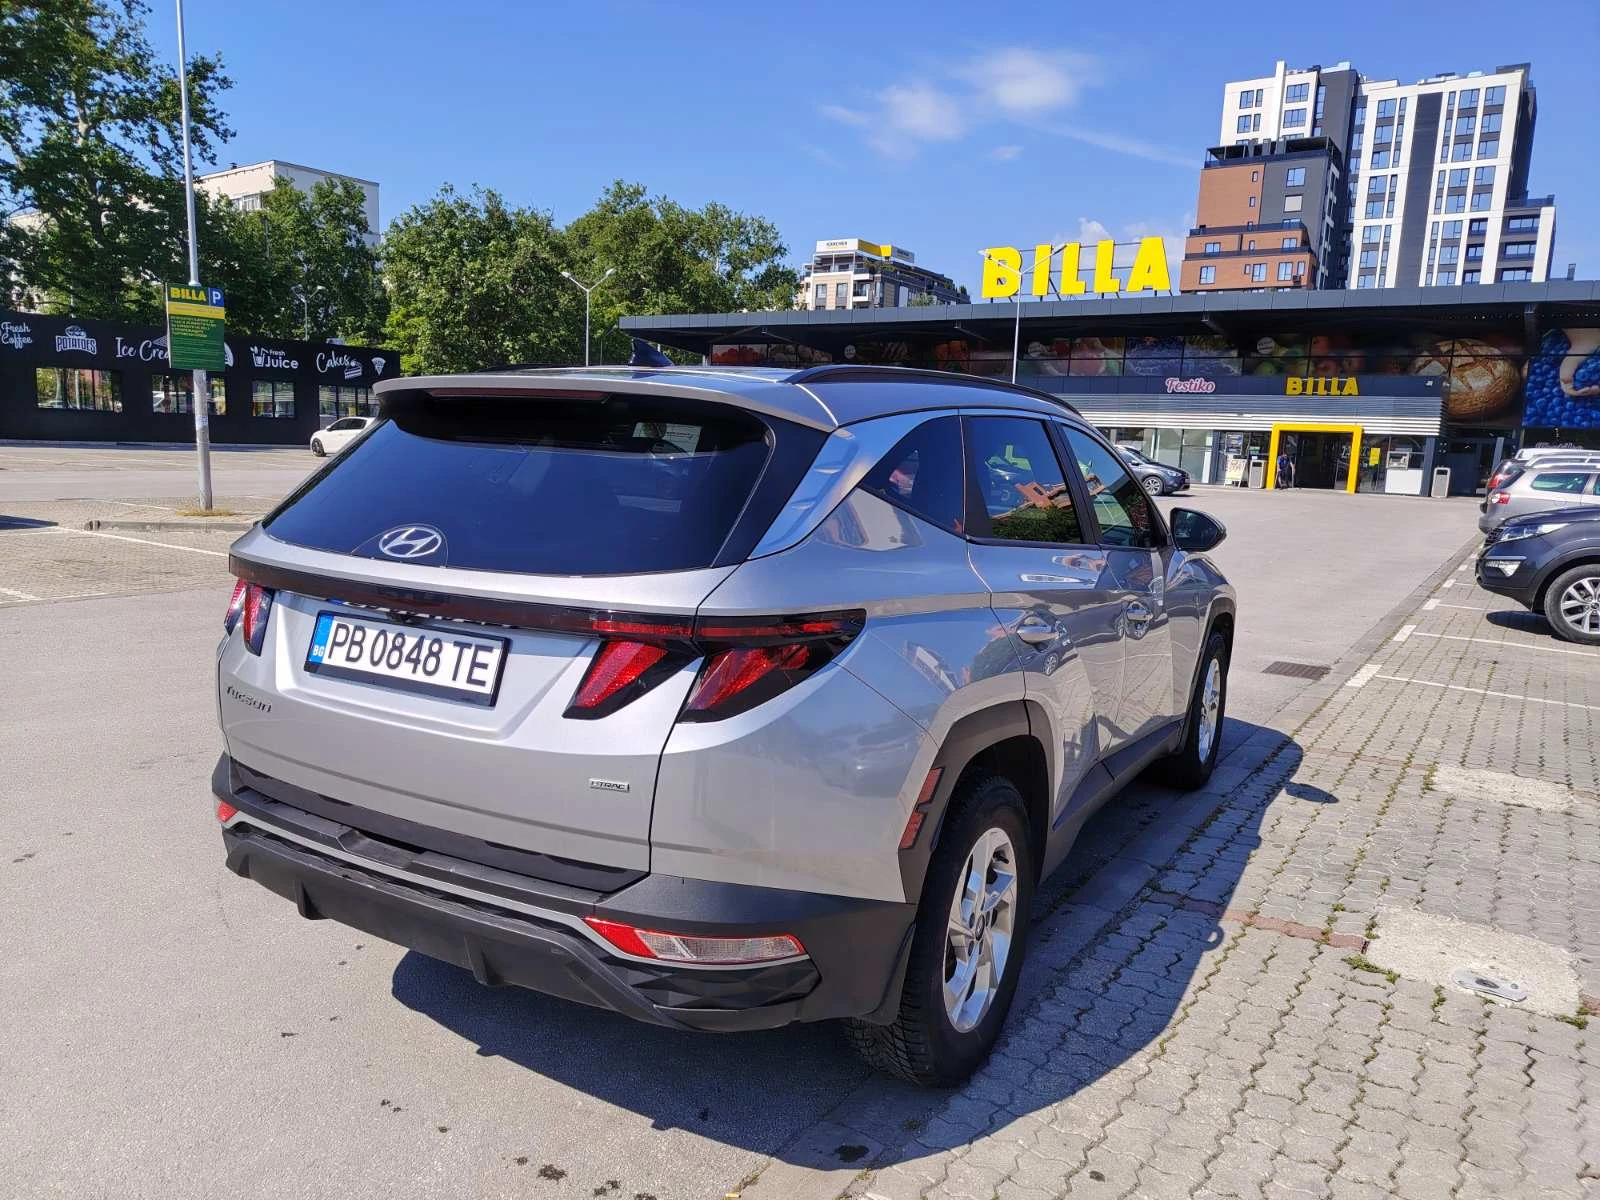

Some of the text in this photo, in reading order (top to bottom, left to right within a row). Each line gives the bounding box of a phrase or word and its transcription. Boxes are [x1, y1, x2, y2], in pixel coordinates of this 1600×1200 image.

[982, 236, 1171, 298] BILLA
[170, 287, 206, 302] BILLA
[212, 291, 222, 304] P
[1, 322, 31, 333] Fresh
[1, 332, 33, 349] Coffee
[56, 335, 97, 355] POTATOES
[115, 337, 136, 358] Ice
[139, 339, 169, 361] Crea
[269, 349, 286, 357] Fresh
[265, 355, 299, 369] Juice
[316, 350, 350, 373] Cakes
[1165, 377, 1216, 393] Festiko
[1286, 377, 1359, 396] BILLA
[312, 645, 325, 657] BG
[327, 622, 495, 687] PB 0848 TE
